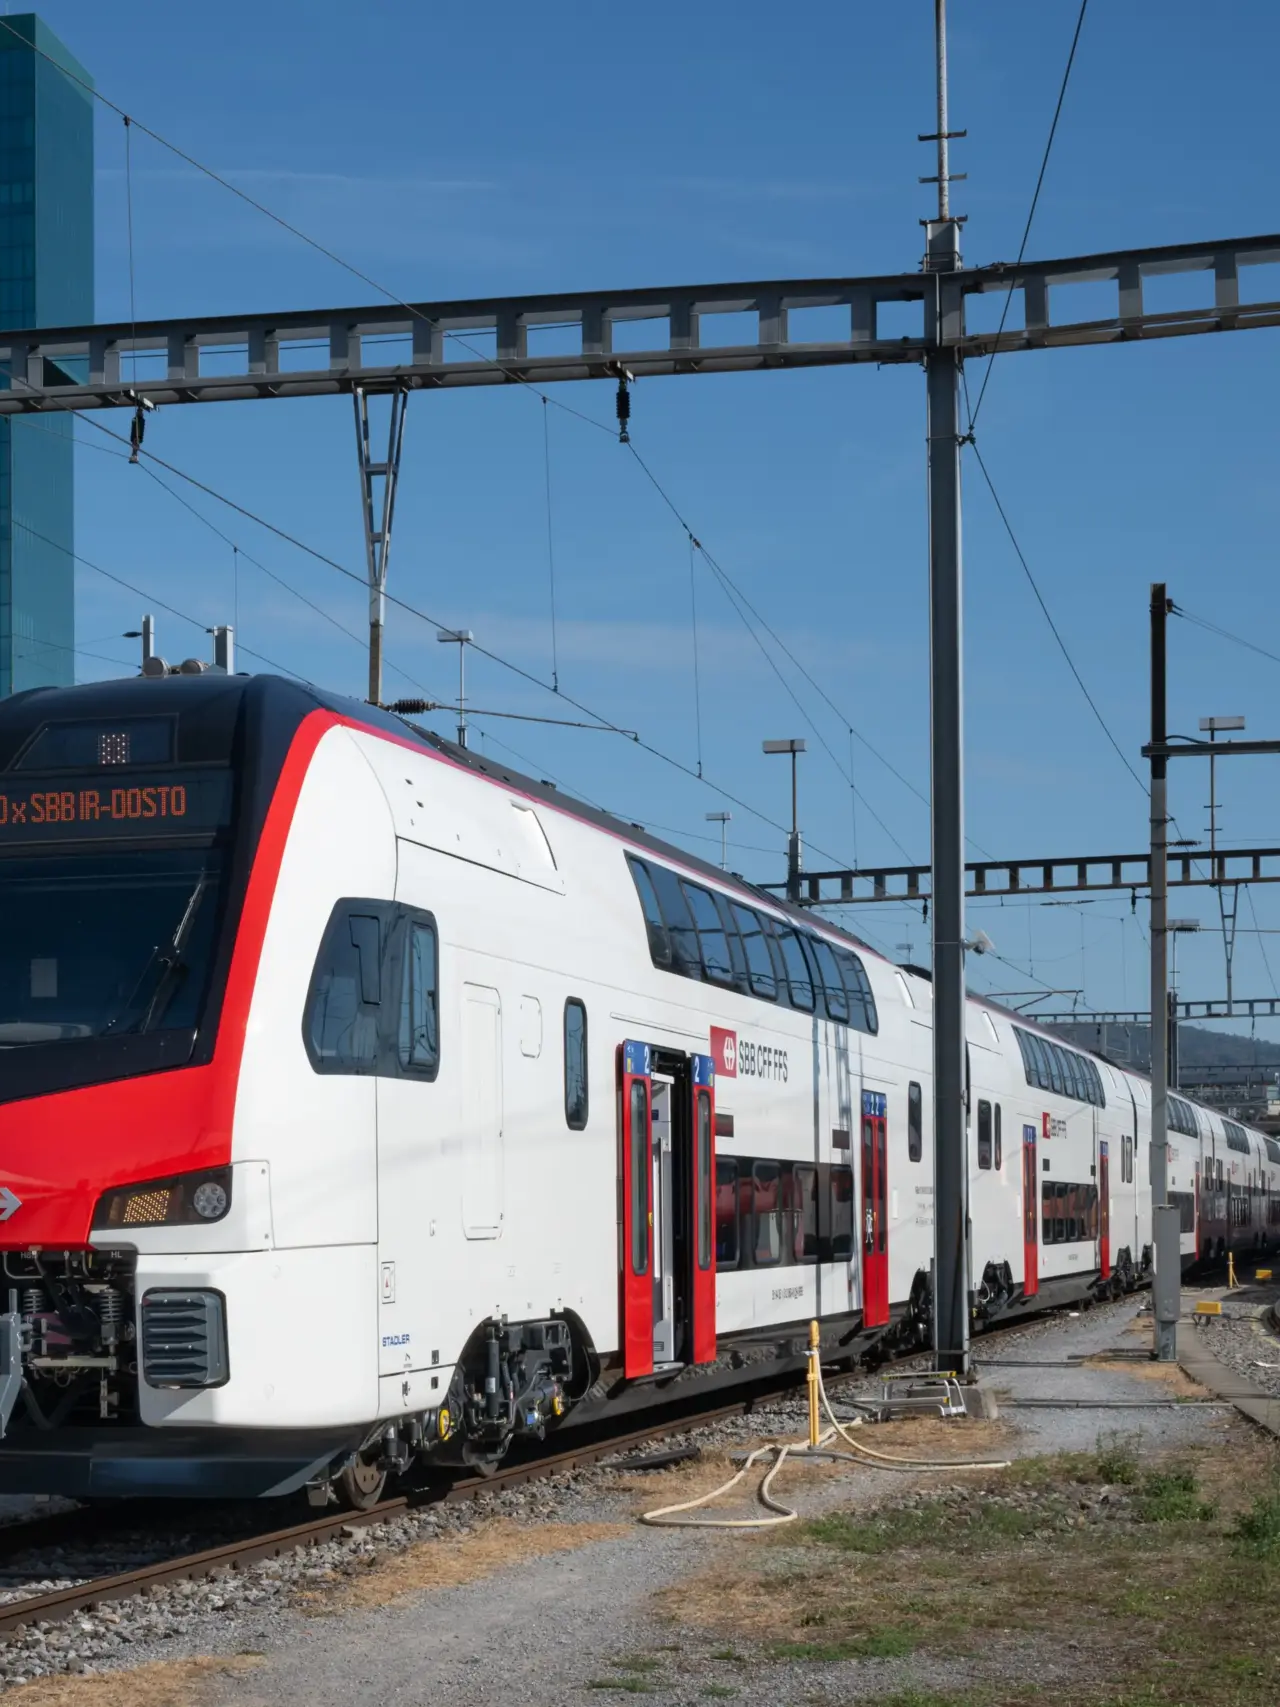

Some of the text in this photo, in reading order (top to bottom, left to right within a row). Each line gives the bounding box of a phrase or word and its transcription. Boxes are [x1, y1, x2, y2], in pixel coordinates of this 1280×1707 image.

[31, 791, 75, 823] SBB
[644, 1045, 650, 1074] 2
[694, 1056, 700, 1083] 2
[739, 1040, 788, 1083] SBB CFF FFS
[382, 1334, 410, 1347] STADLER
